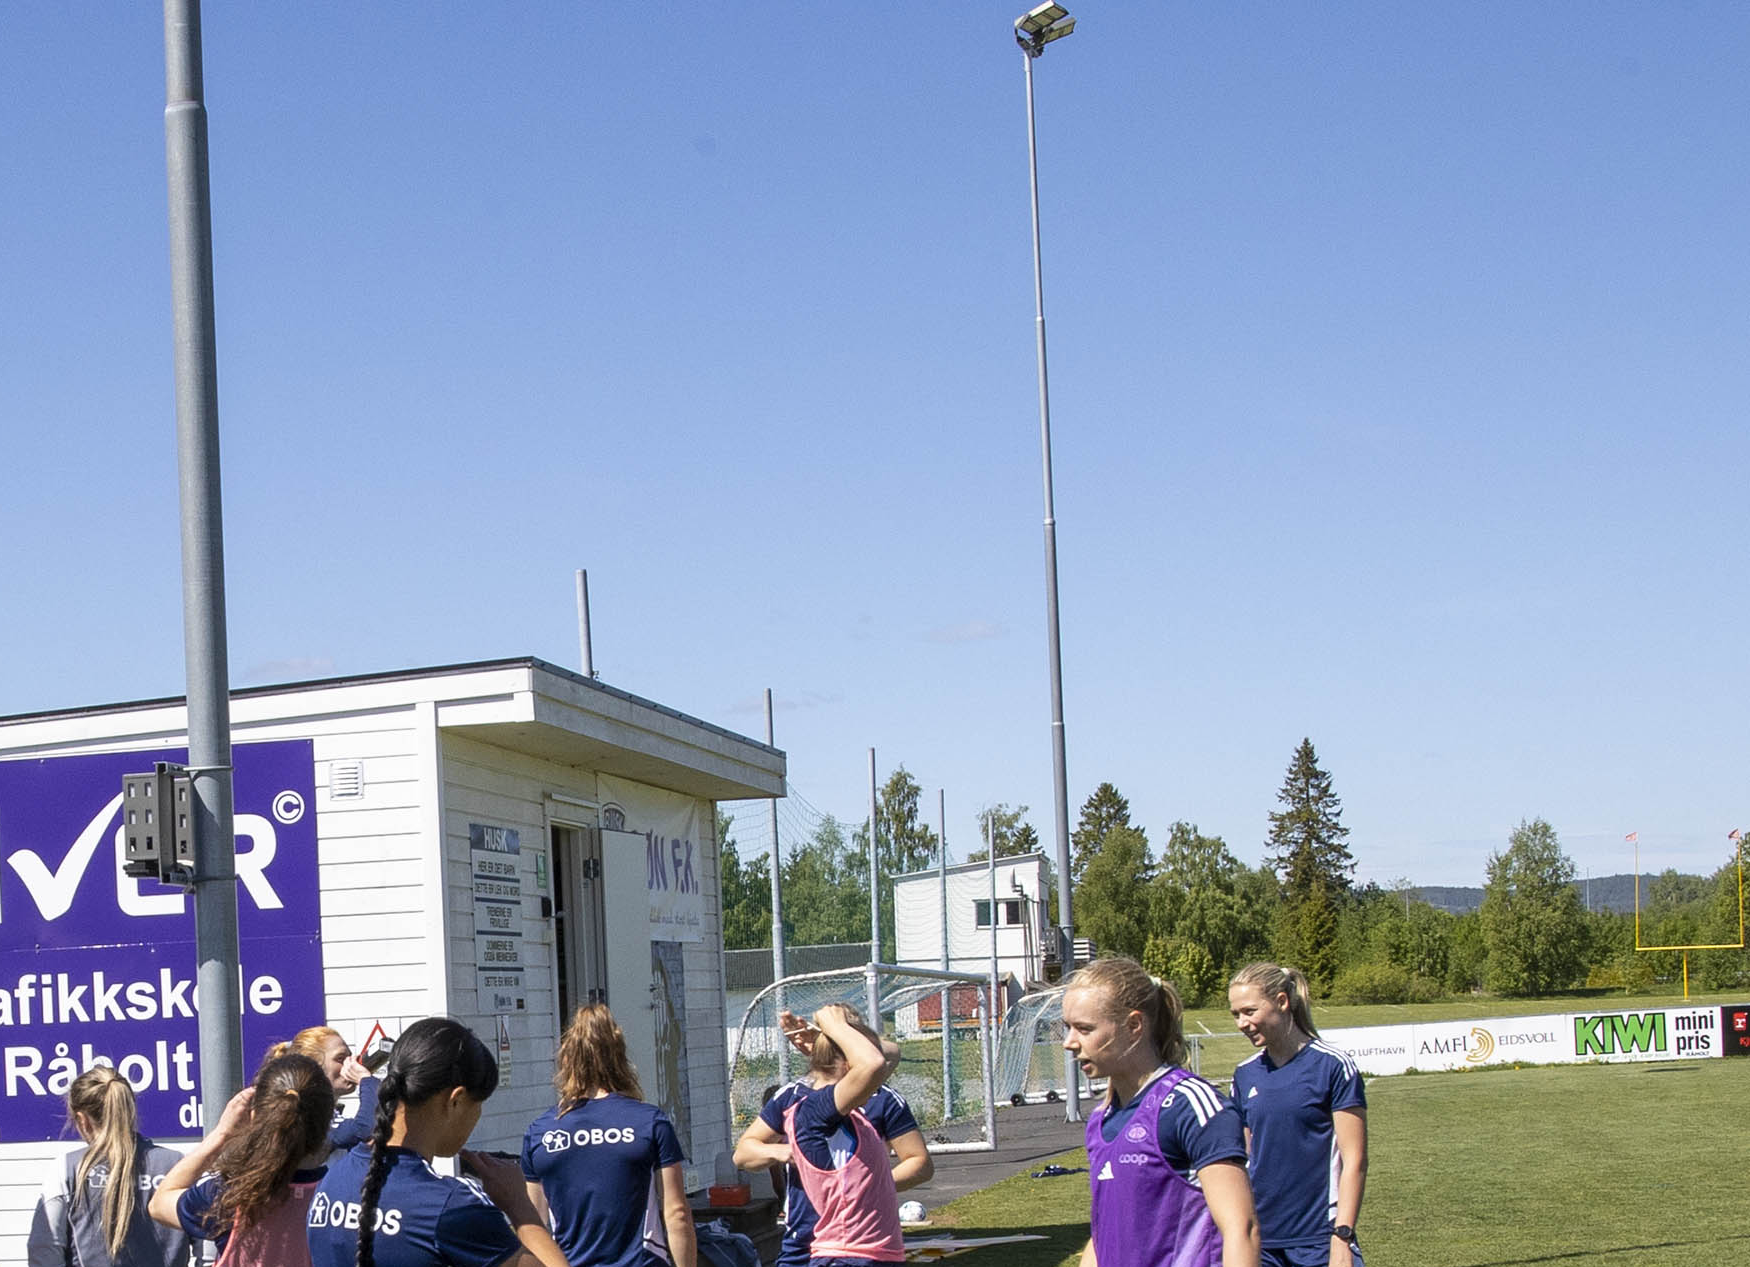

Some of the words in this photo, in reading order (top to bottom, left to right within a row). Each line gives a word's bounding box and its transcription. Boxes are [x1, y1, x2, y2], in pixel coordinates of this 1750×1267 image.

[483, 827, 508, 852] HUSK
[1675, 1010, 1714, 1031] mini
[1419, 1035, 1467, 1055] AMFI
[1499, 1032, 1558, 1046] EIDSVOLL
[1574, 1012, 1667, 1056] KIWI
[1676, 1031, 1711, 1056] pris
[1358, 1047, 1406, 1057] LUFTHAVN
[573, 1127, 635, 1146] OBOS
